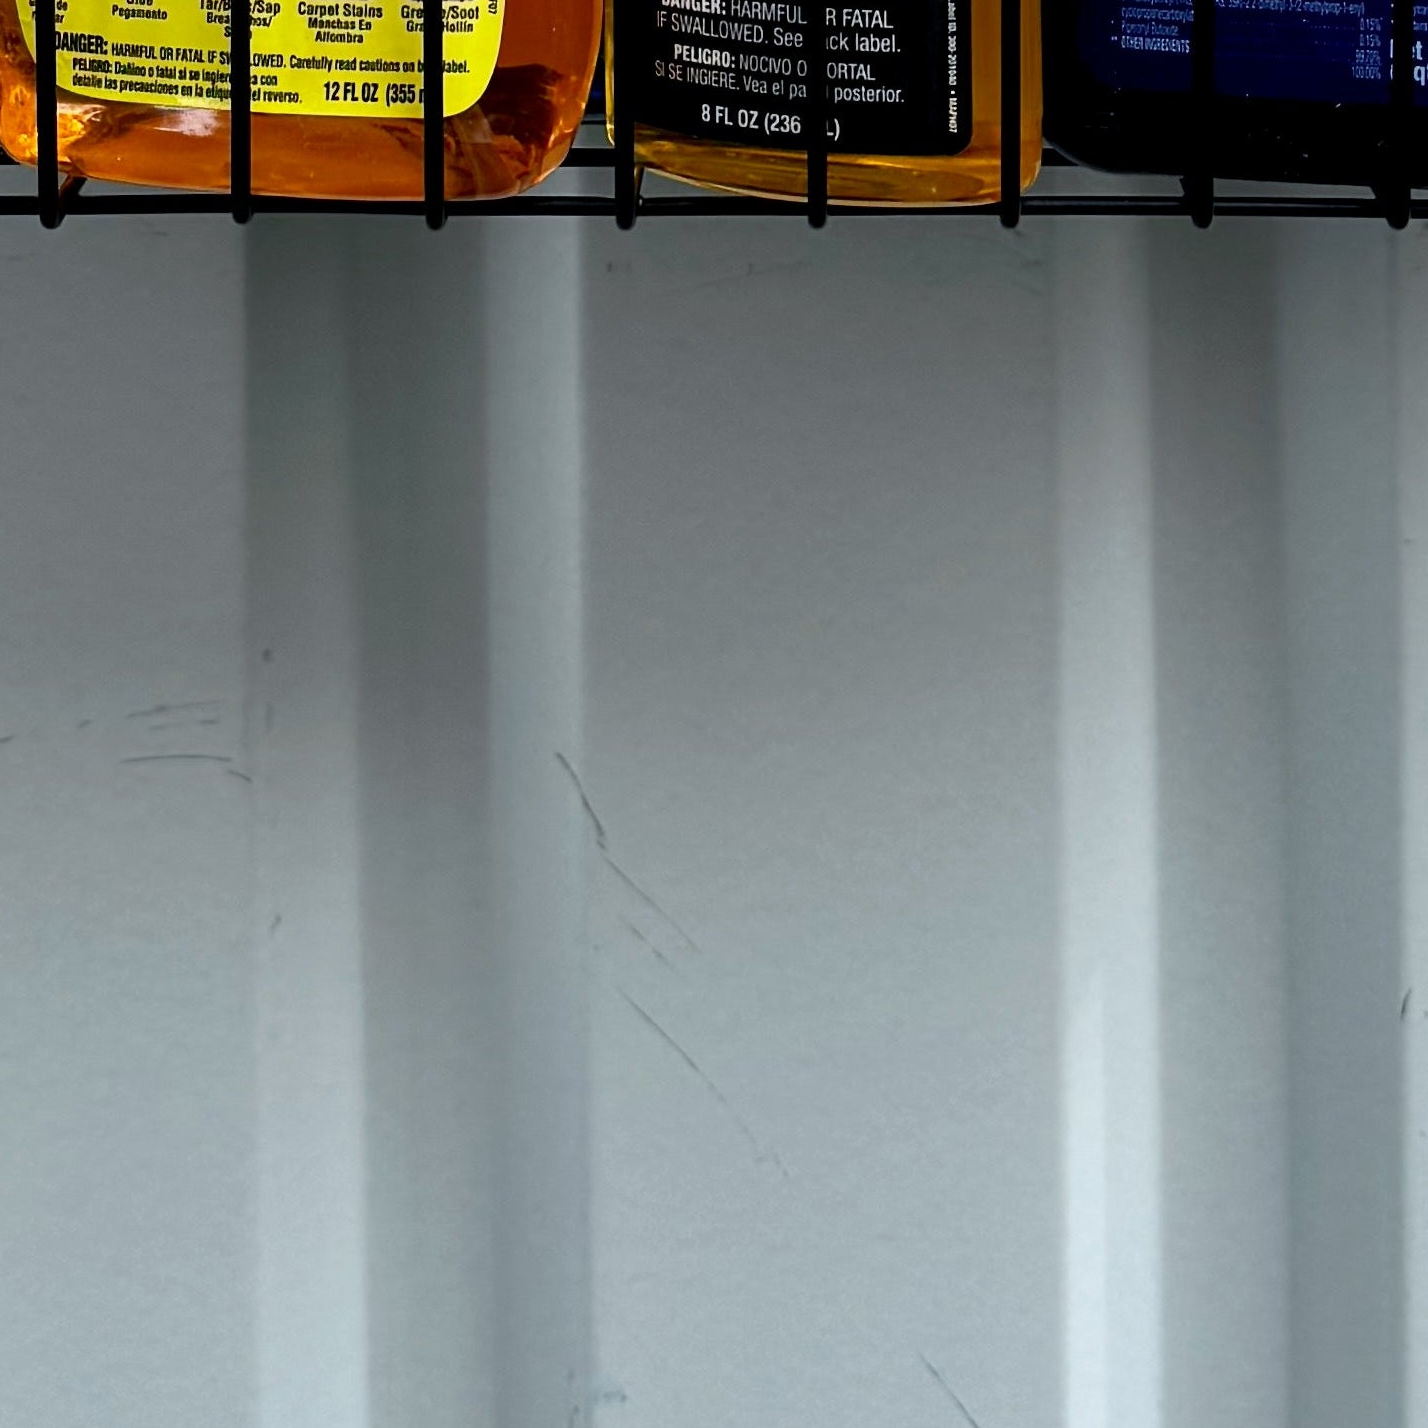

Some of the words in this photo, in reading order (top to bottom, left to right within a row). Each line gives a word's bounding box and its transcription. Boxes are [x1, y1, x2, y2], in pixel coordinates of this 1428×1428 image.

[298, 2, 340, 19] Carpet
[343, 2, 383, 19] Stains
[731, 0, 808, 25] HARMFUL
[842, 8, 894, 29] FATAL
[657, 10, 667, 28] IF
[671, 13, 768, 44] SWALLOWED.
[773, 27, 804, 48] See
[855, 33, 901, 52] label.
[111, 43, 157, 60] HARMFUL
[159, 46, 174, 61] OR
[176, 47, 205, 64] FATAL
[674, 43, 736, 69] PELIGRO:
[739, 54, 792, 76] NOCIVO
[324, 81, 340, 101] 12
[343, 82, 359, 102] FL
[362, 82, 379, 103] OZ
[386, 82, 416, 108] (355
[668, 63, 683, 81] SE
[687, 66, 740, 91] INGIERE.
[743, 75, 767, 94] Vea
[772, 77, 784, 95] el
[834, 86, 905, 104] posterior.
[701, 104, 711, 122] 8
[715, 105, 733, 126] FL
[738, 108, 759, 129] OZ
[764, 112, 802, 135] (236
